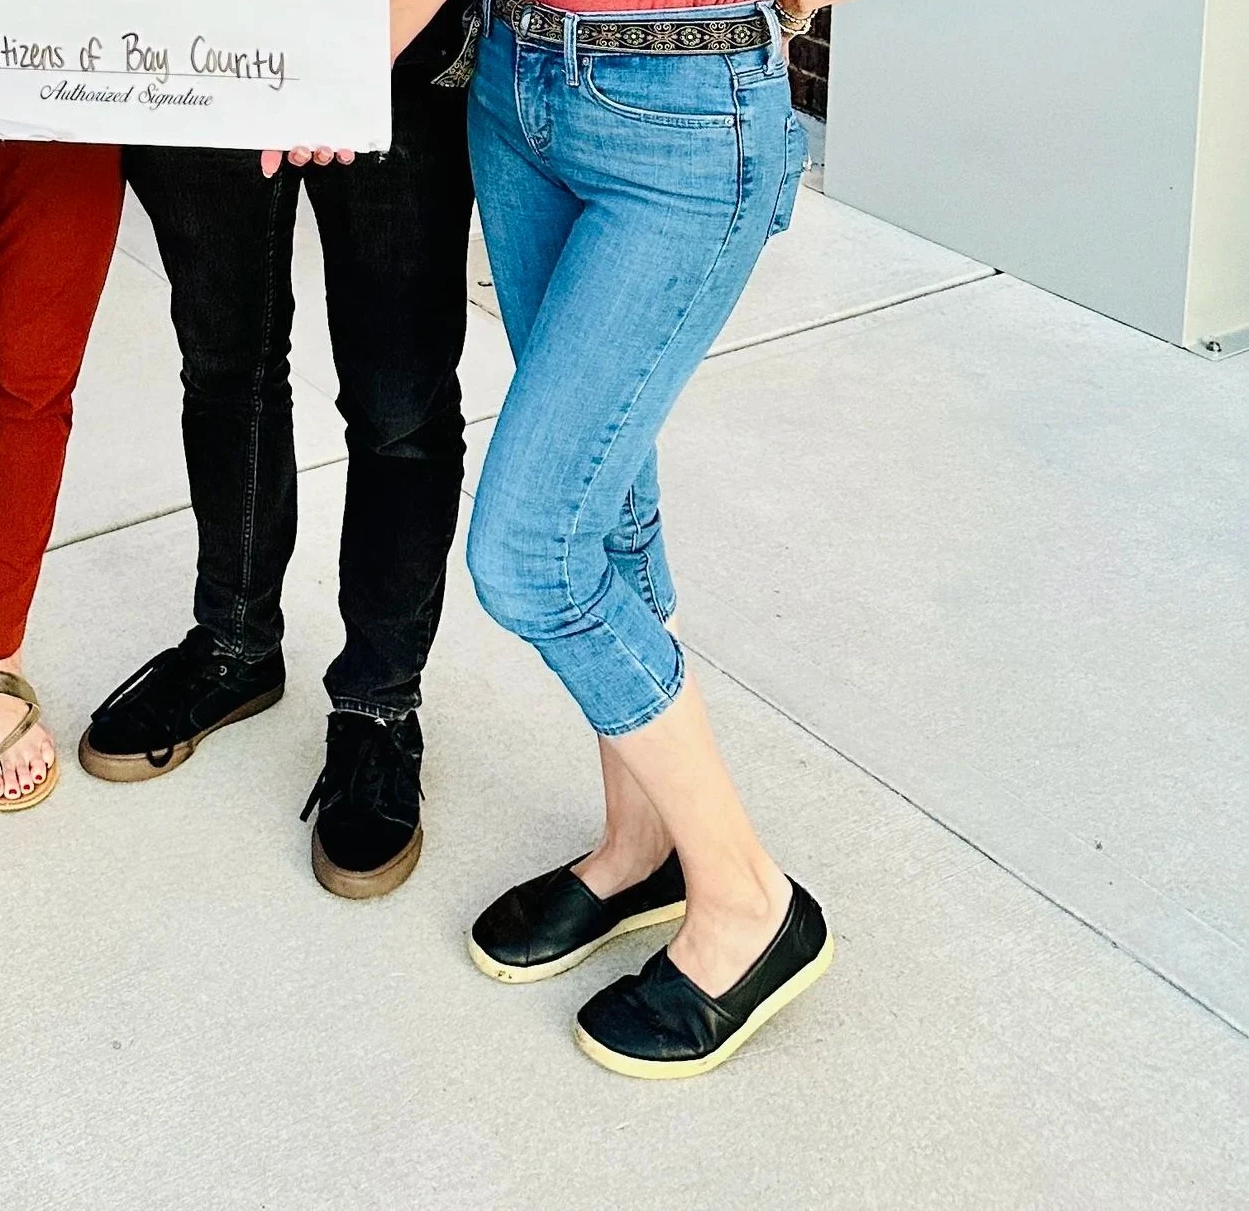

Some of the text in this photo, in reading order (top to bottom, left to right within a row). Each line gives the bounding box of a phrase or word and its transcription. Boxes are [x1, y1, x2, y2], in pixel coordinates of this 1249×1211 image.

[79, 37, 103, 72] of
[121, 33, 171, 84] Bay
[190, 35, 287, 92] County
[39, 80, 214, 111] Authorized Signature
